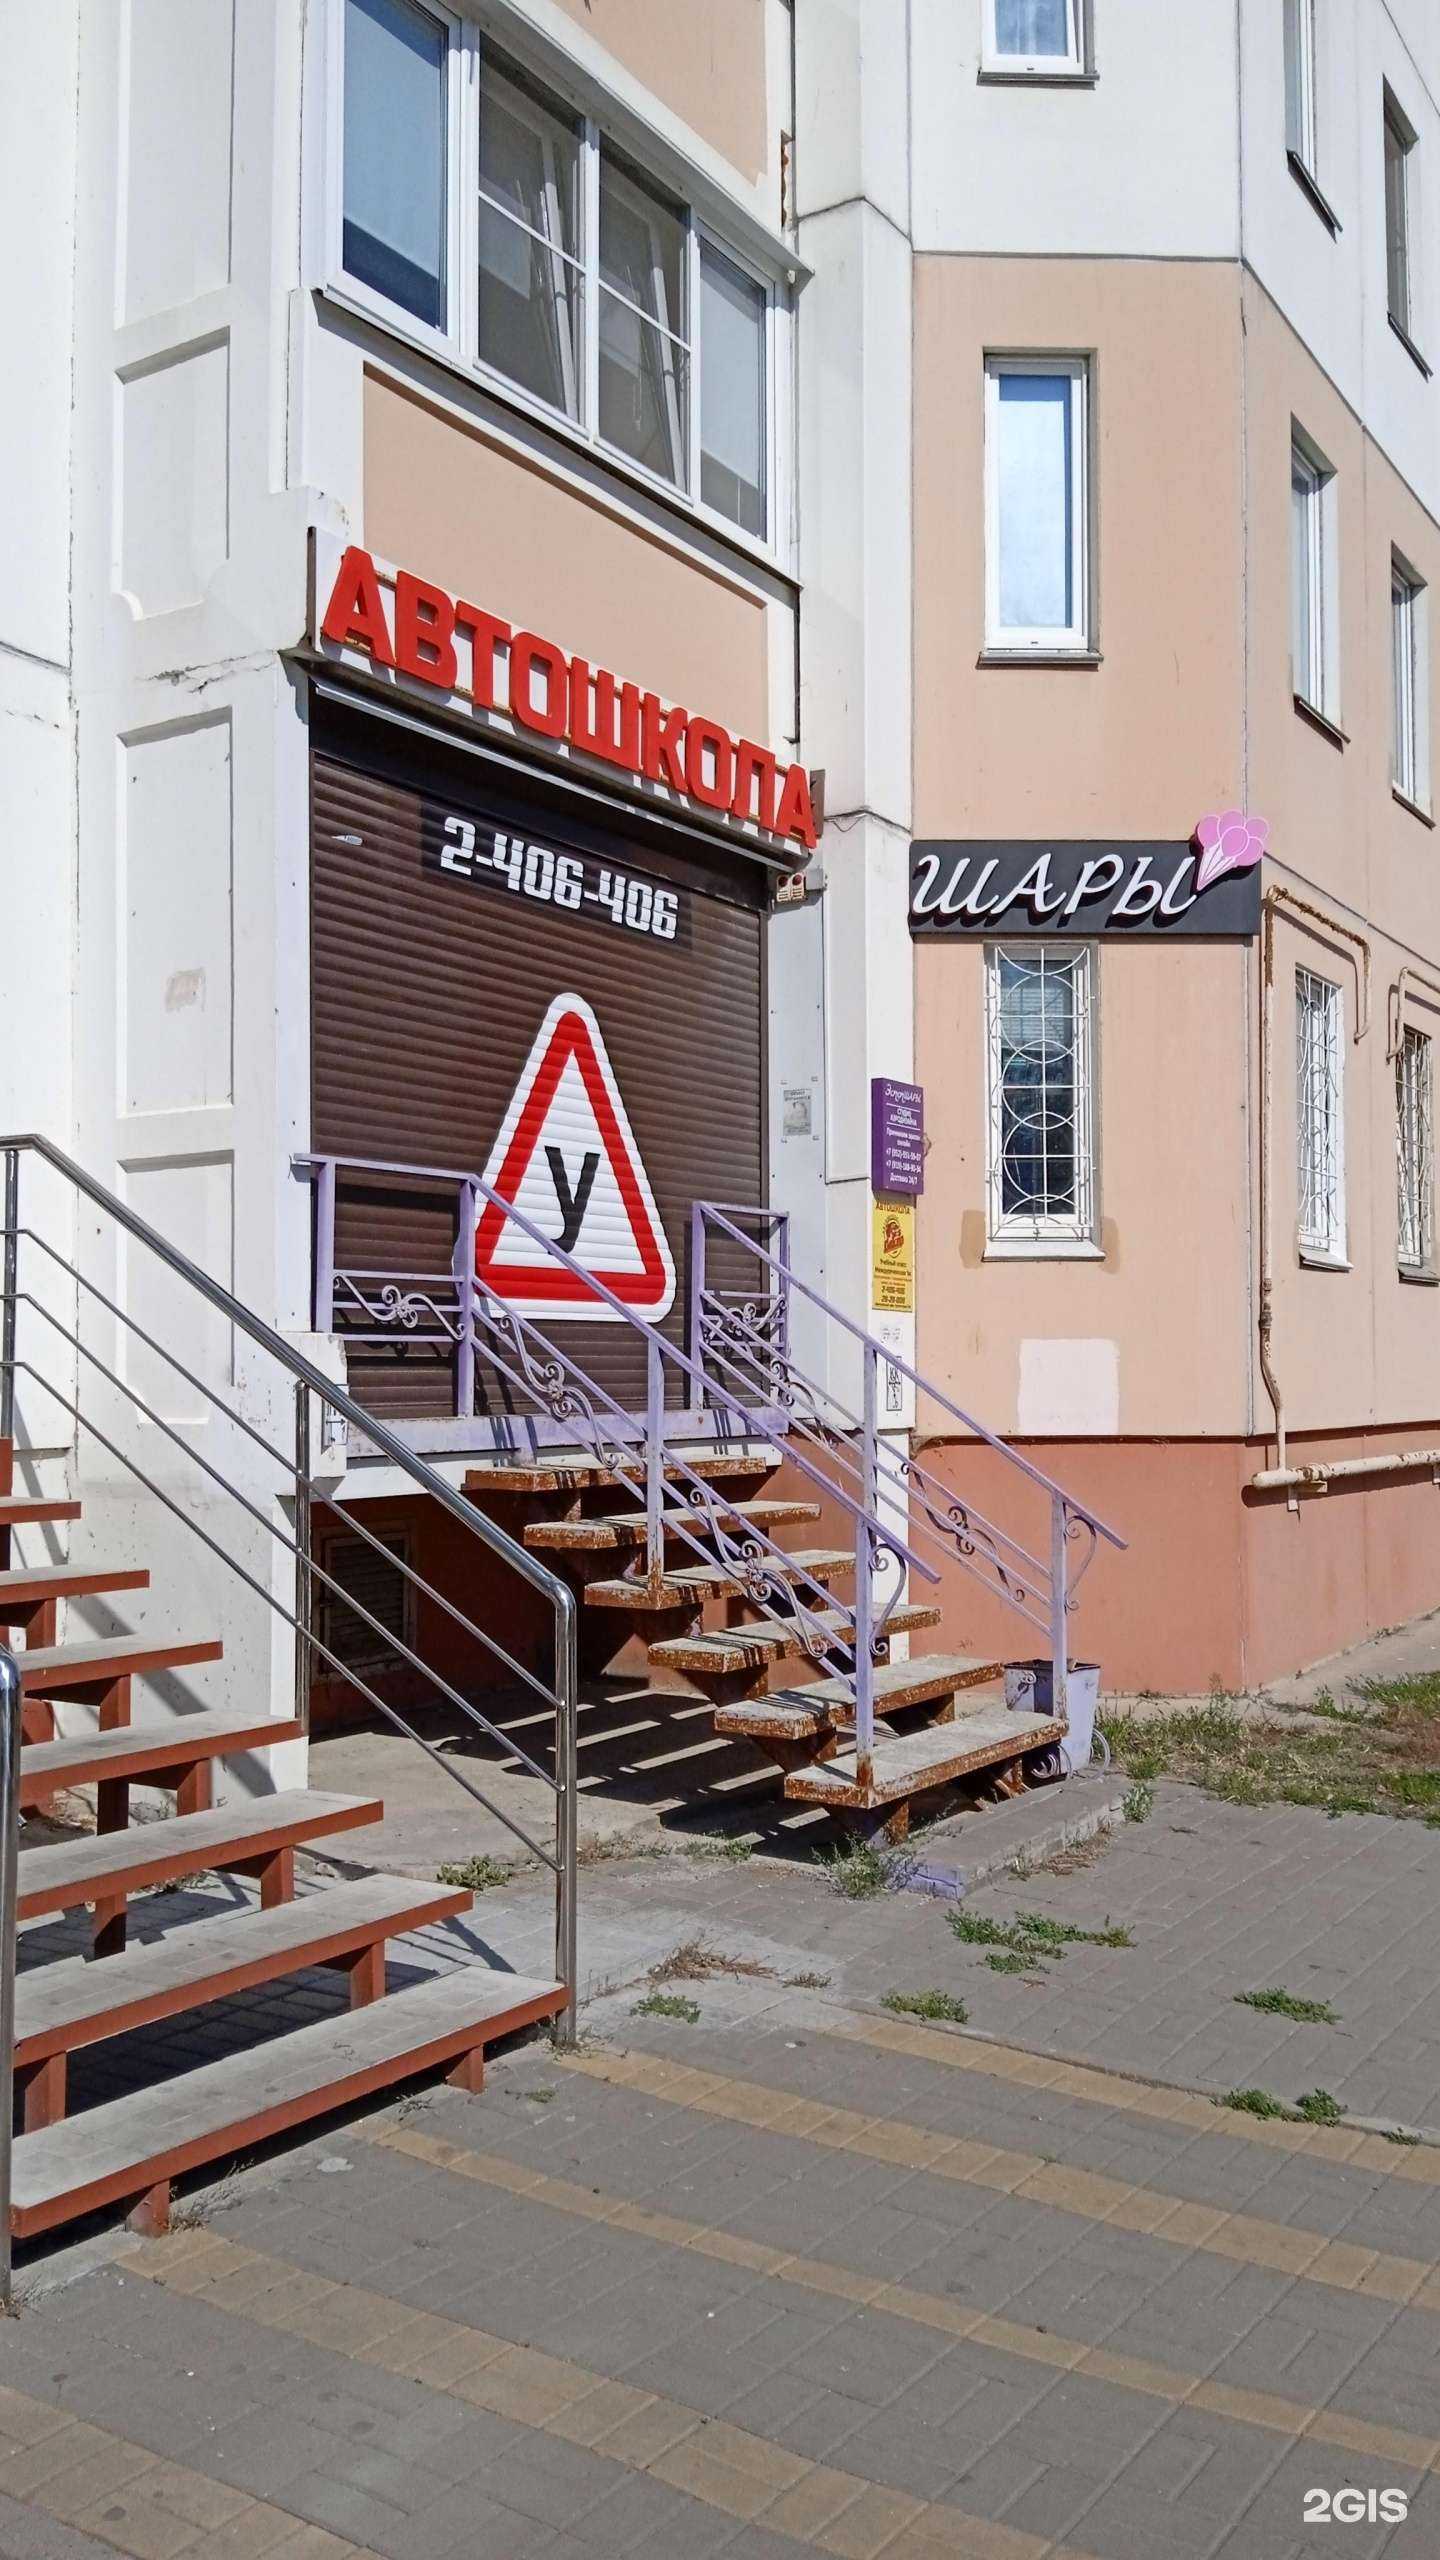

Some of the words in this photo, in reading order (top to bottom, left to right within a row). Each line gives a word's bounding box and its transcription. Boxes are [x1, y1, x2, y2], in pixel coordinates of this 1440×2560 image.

[321, 545, 817, 849] АВТОШКОЛА
[439, 816, 679, 941] 2-406-406
[912, 853, 1198, 916] ШАРЫ
